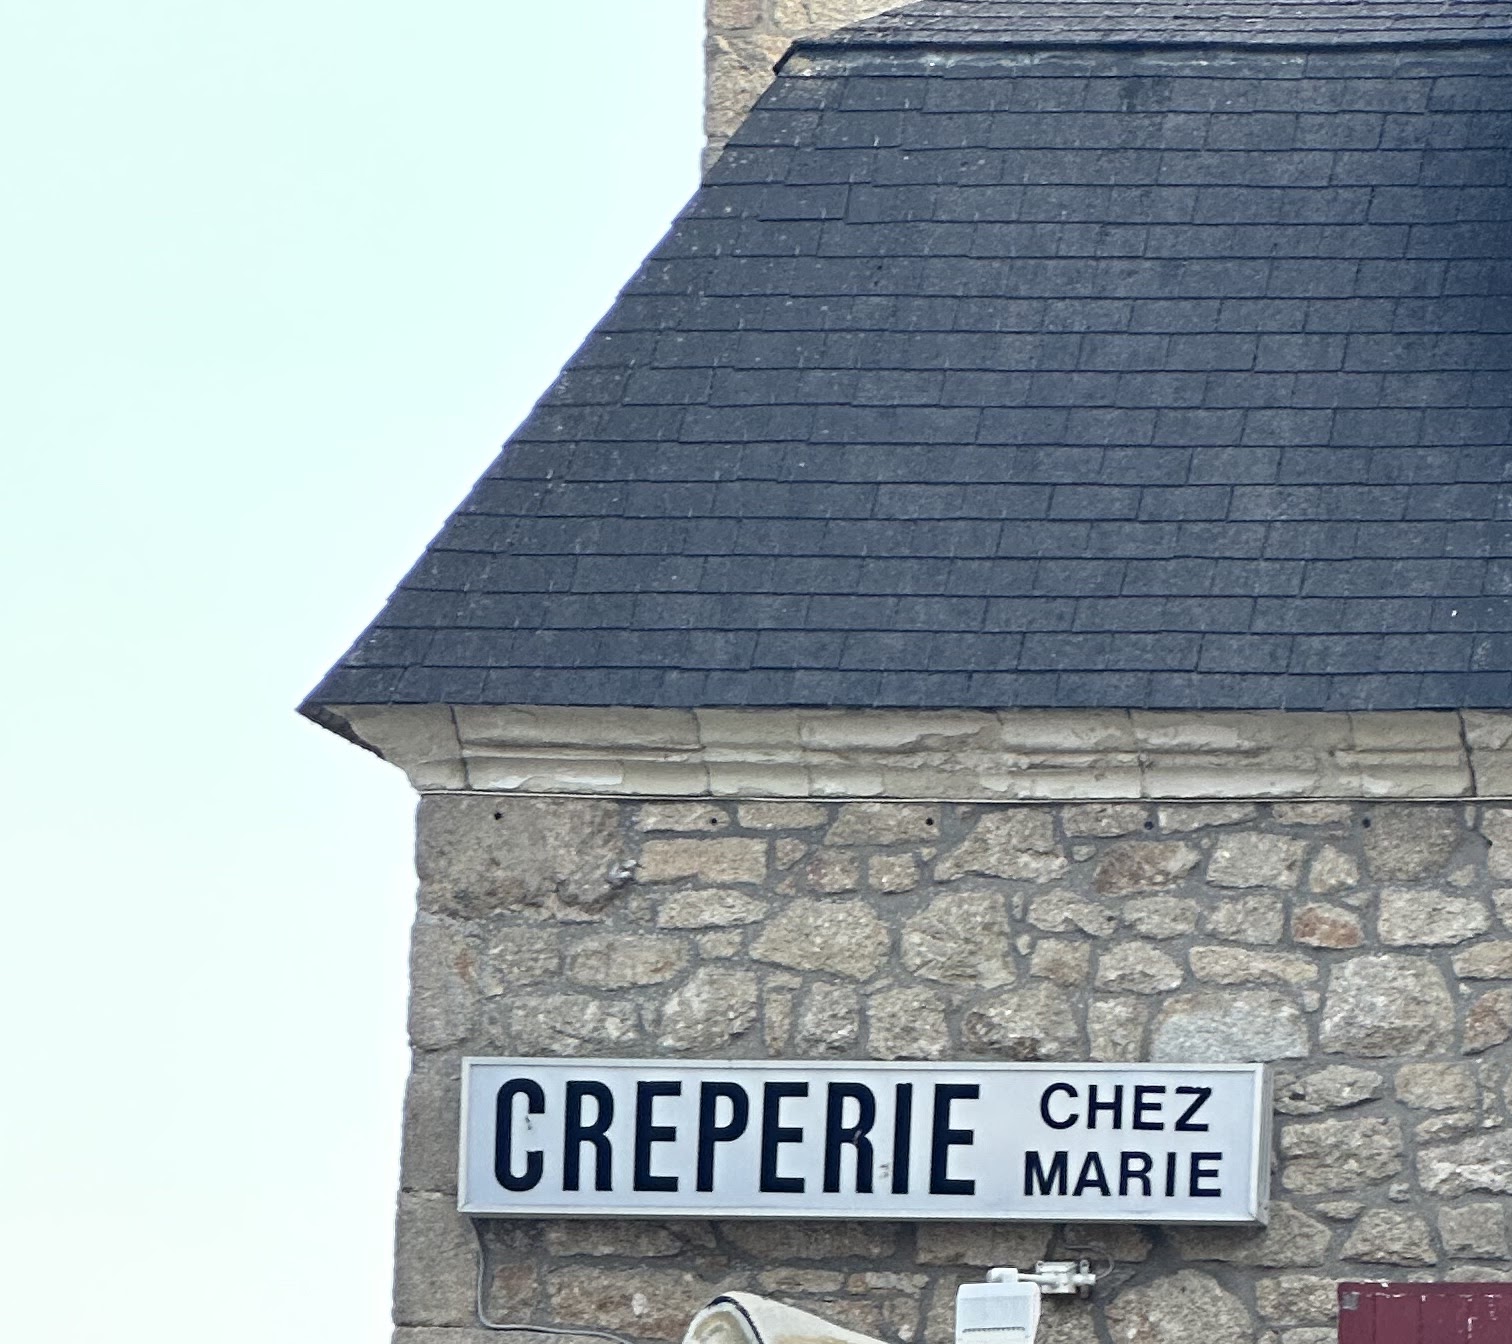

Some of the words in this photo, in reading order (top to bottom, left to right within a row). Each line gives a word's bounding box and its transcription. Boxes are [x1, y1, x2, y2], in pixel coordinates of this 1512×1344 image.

[1039, 1082, 1213, 1132] CHEZ
[494, 1077, 980, 1196] CREPERIE
[1023, 1150, 1223, 1198] MARIE
